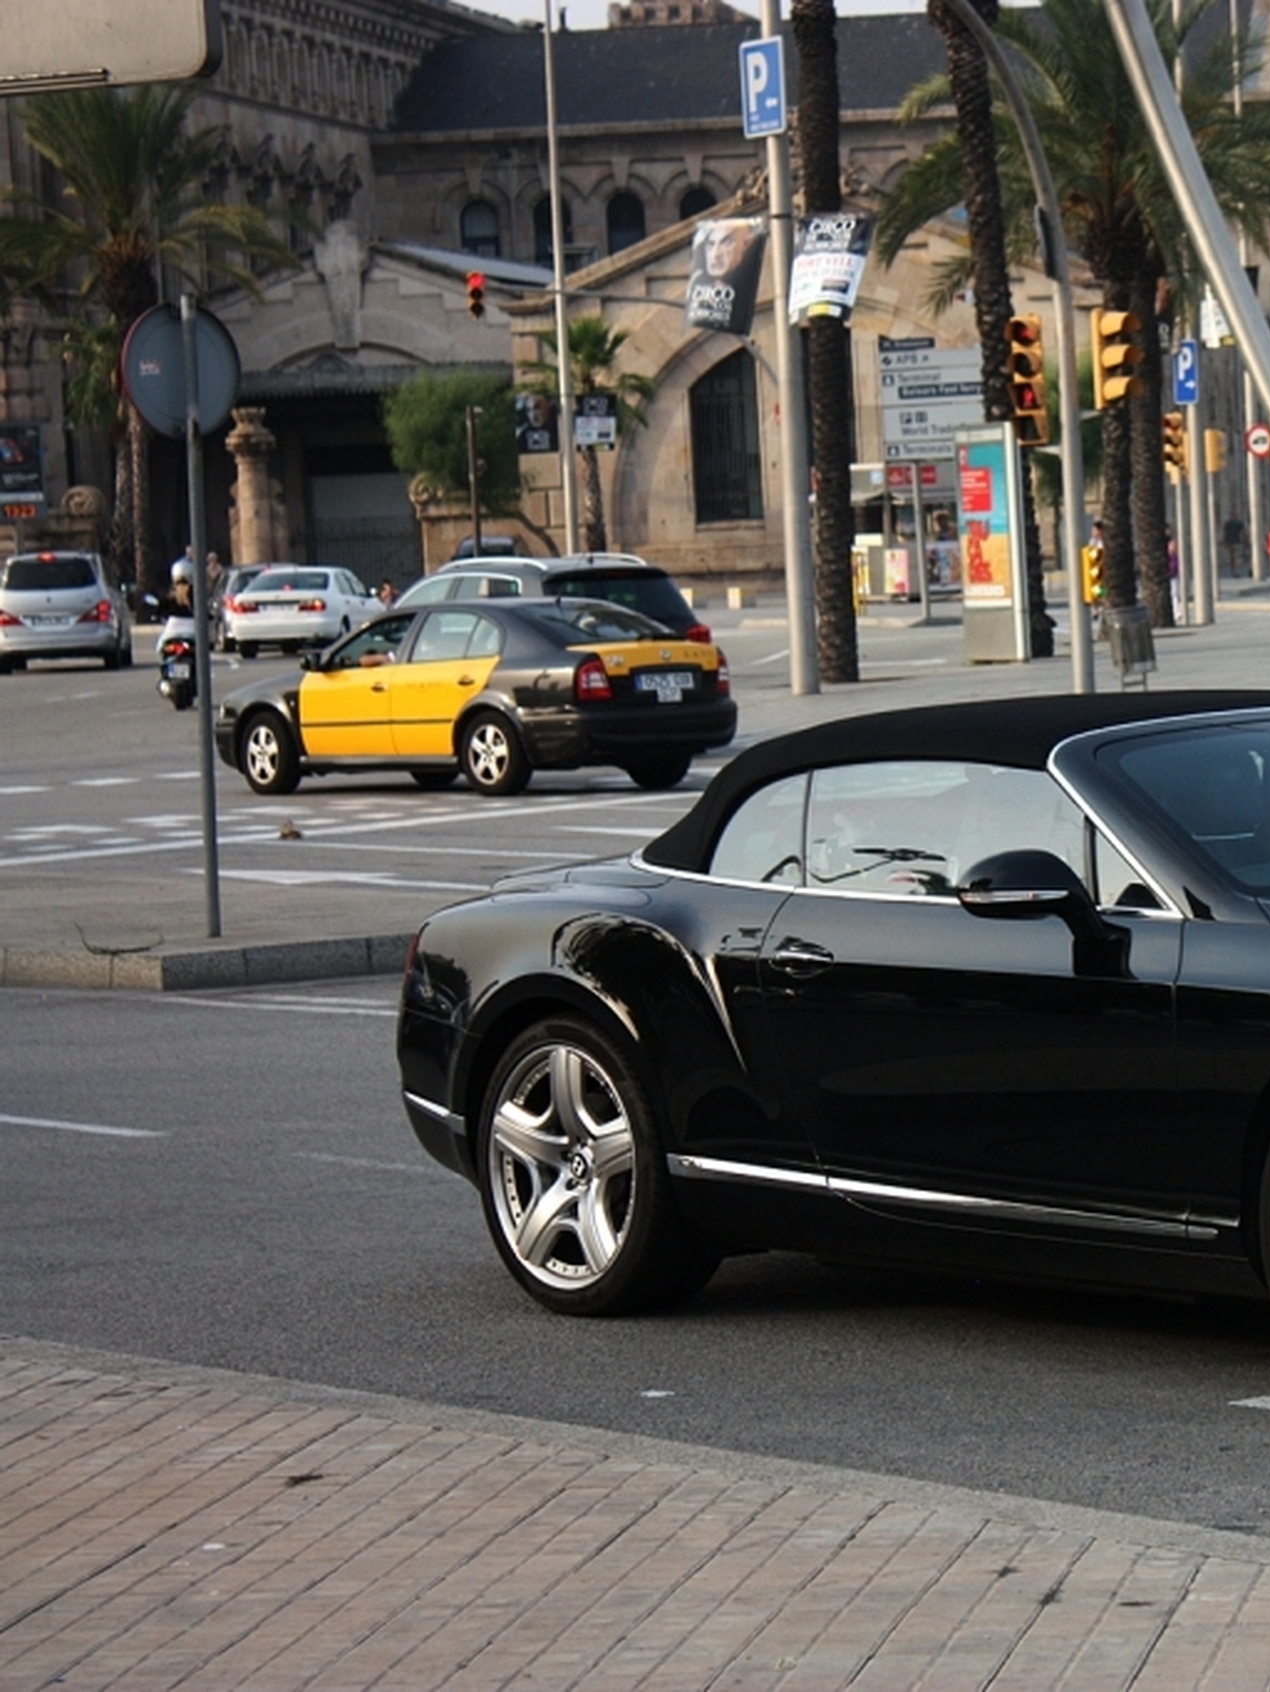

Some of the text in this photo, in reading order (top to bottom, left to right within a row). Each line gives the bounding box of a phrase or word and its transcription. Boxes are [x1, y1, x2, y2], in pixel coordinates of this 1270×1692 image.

[747, 52, 768, 113] P
[1178, 346, 1192, 380] P
[898, 371, 940, 383] Terminal
[902, 426, 928, 436] World
[903, 443, 951, 454] Terminals
